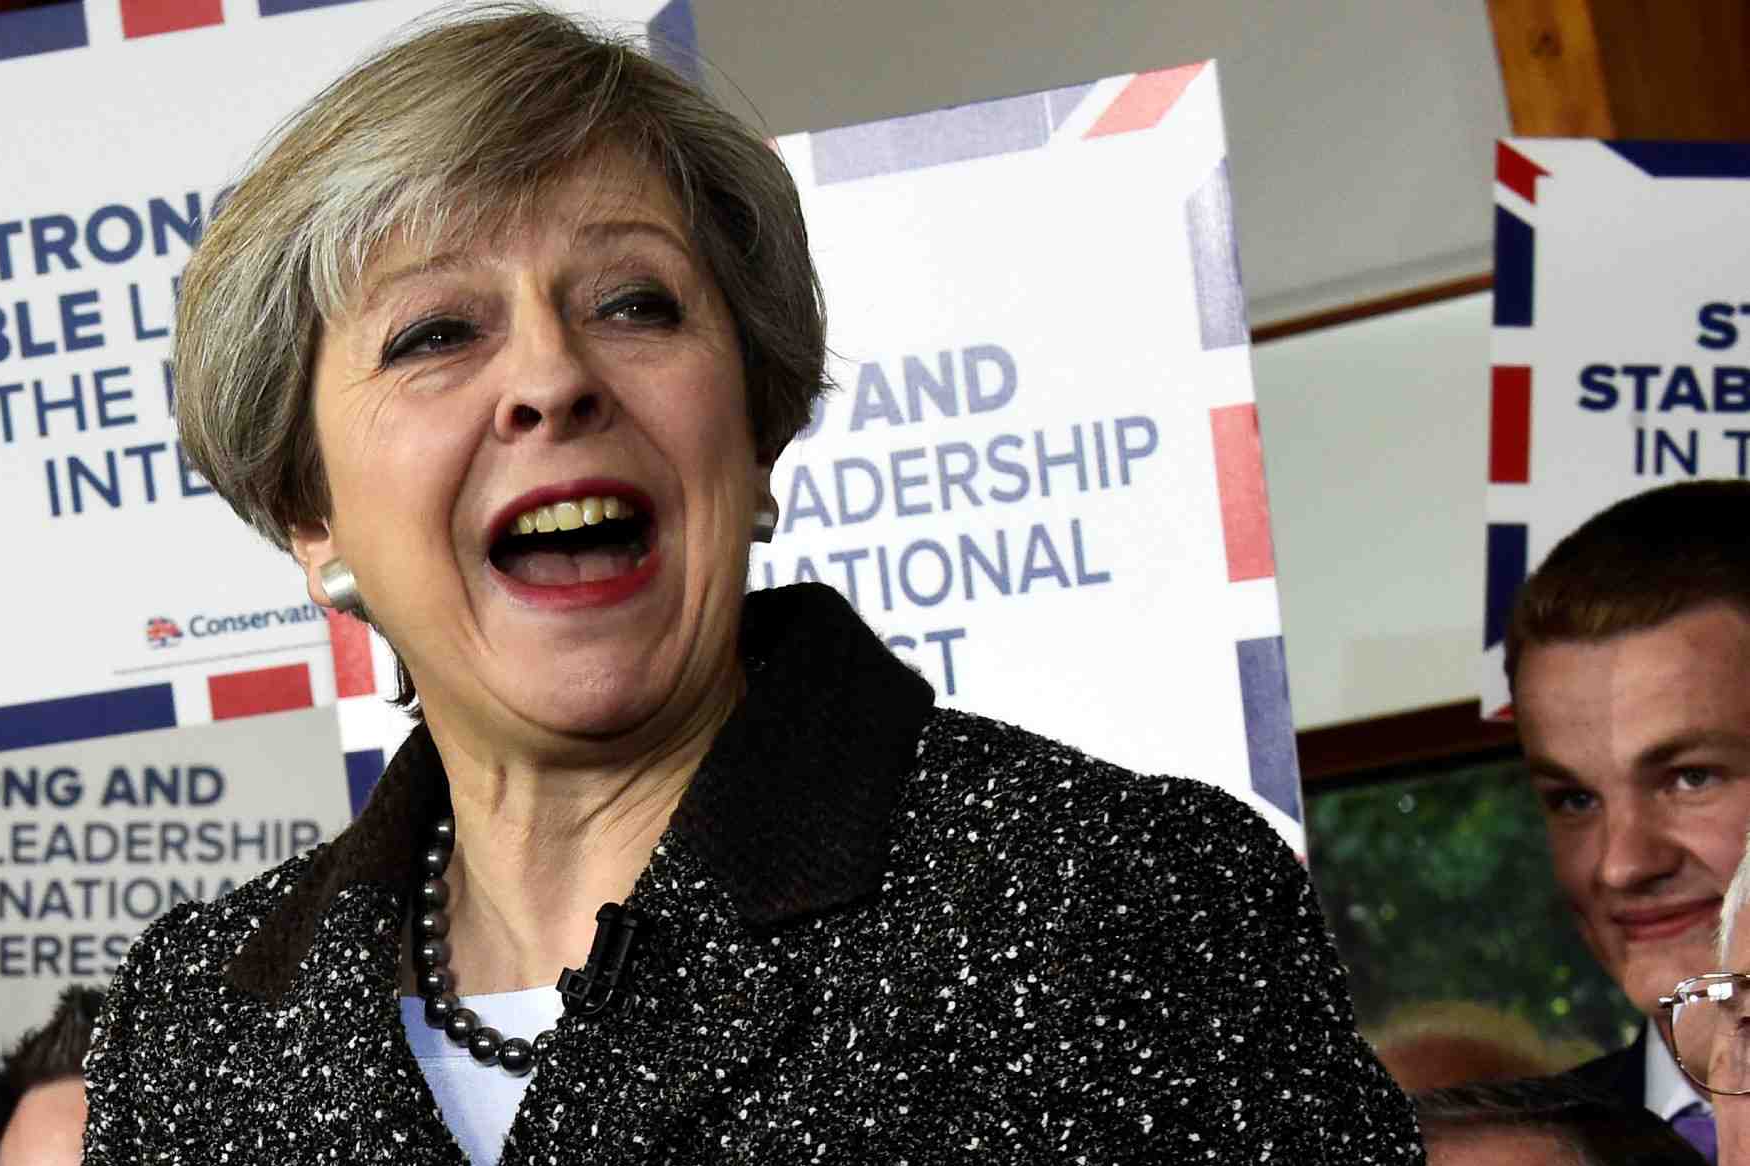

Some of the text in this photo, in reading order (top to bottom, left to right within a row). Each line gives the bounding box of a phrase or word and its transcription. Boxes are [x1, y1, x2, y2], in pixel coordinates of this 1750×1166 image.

[849, 344, 1018, 432] AND
[1578, 364, 1750, 413] STAB
[781, 415, 1161, 534] ADERSHIP
[1634, 426, 1699, 476] IN
[100, 765, 225, 808] AND
